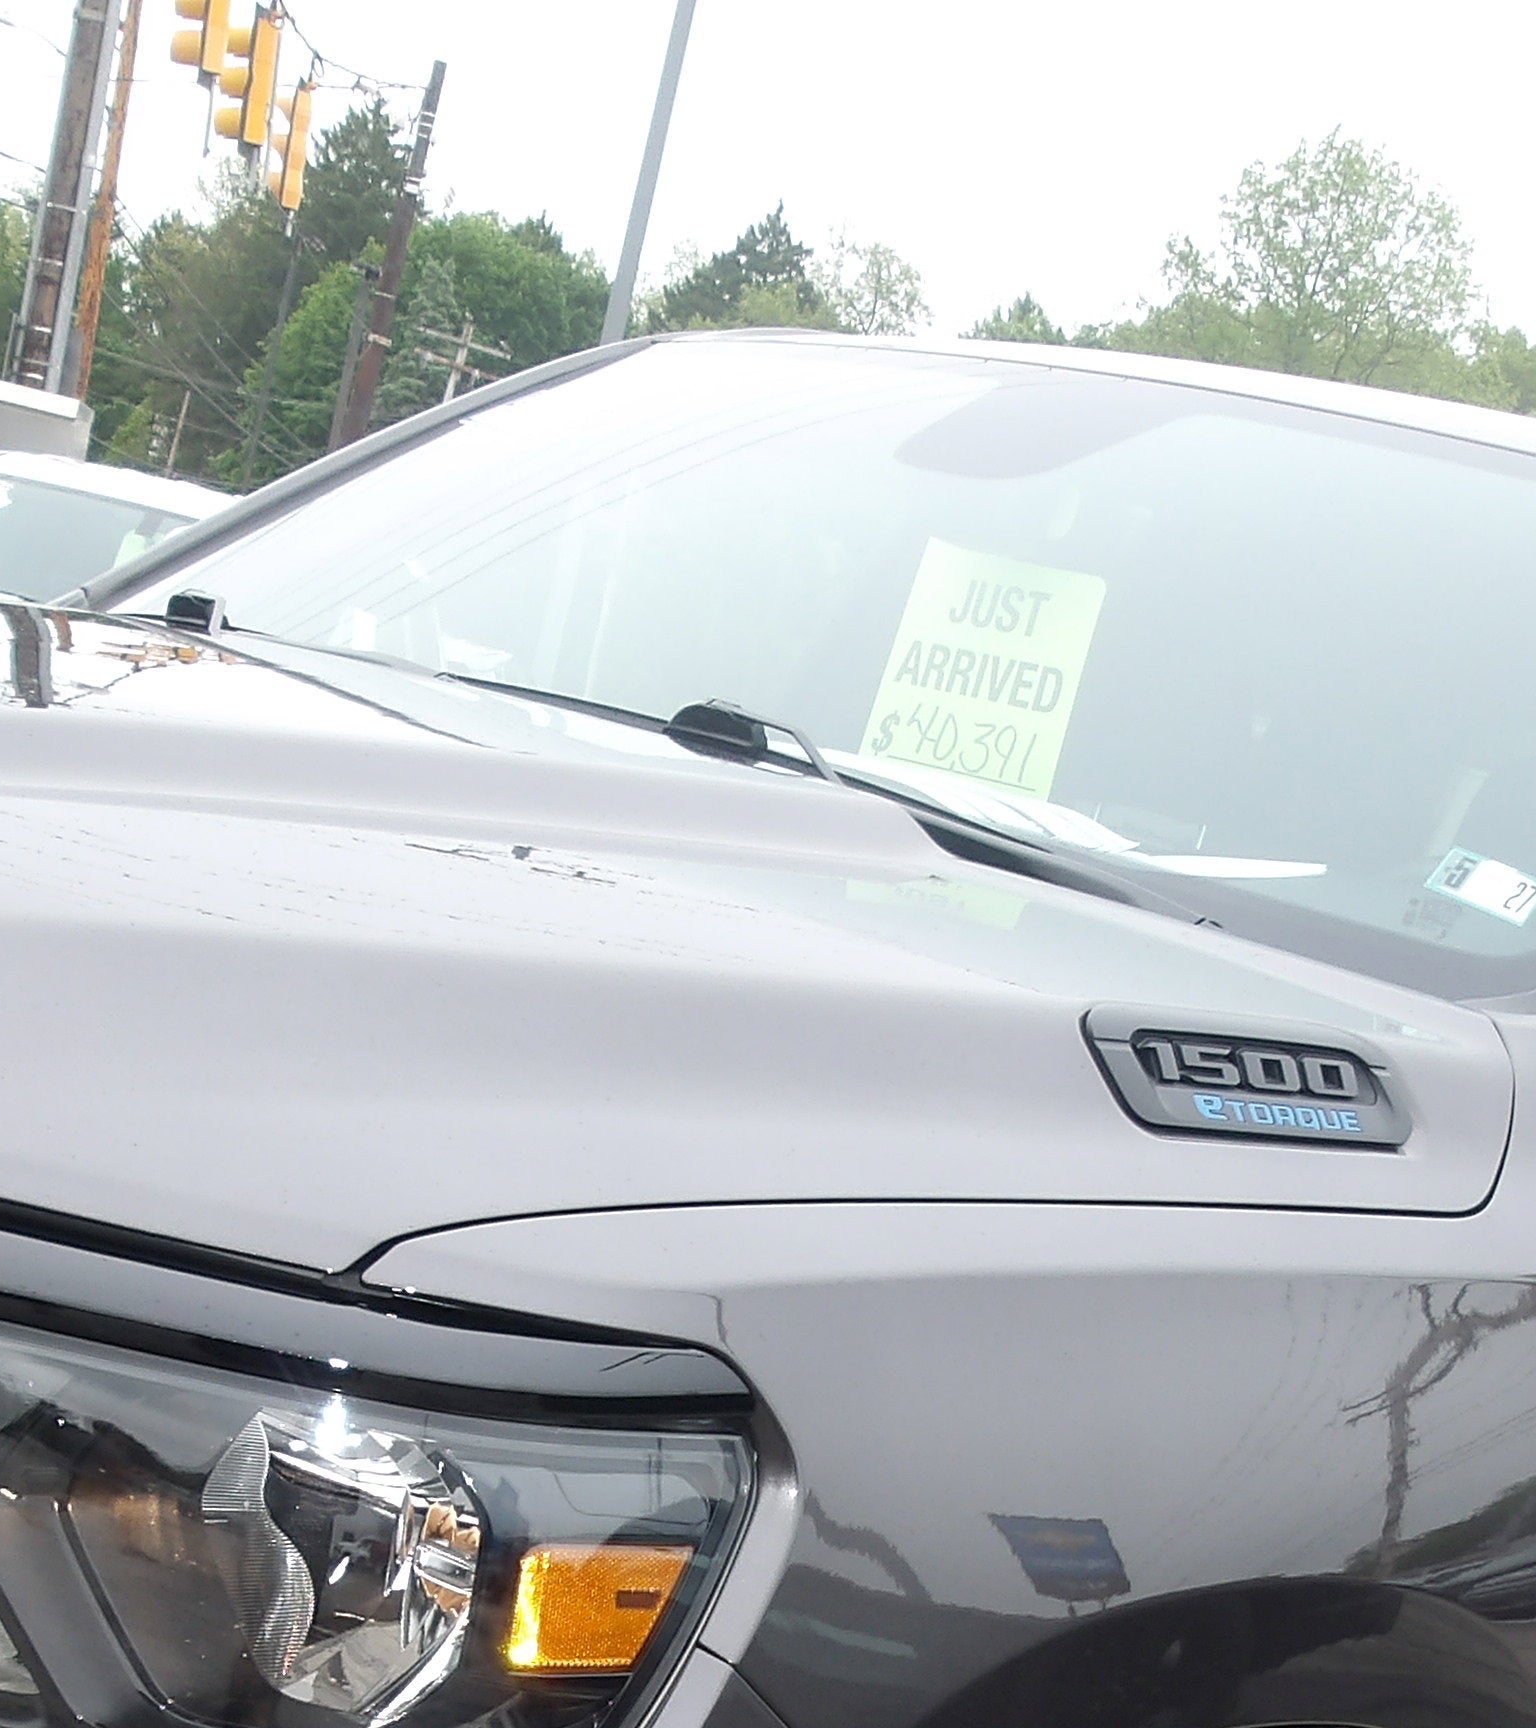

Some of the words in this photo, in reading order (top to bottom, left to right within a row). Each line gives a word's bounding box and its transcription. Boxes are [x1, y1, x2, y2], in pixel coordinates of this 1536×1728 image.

[949, 580, 1053, 637] JUST
[894, 640, 1064, 713] ARRIVED
[1136, 1037, 1360, 1099] 1500
